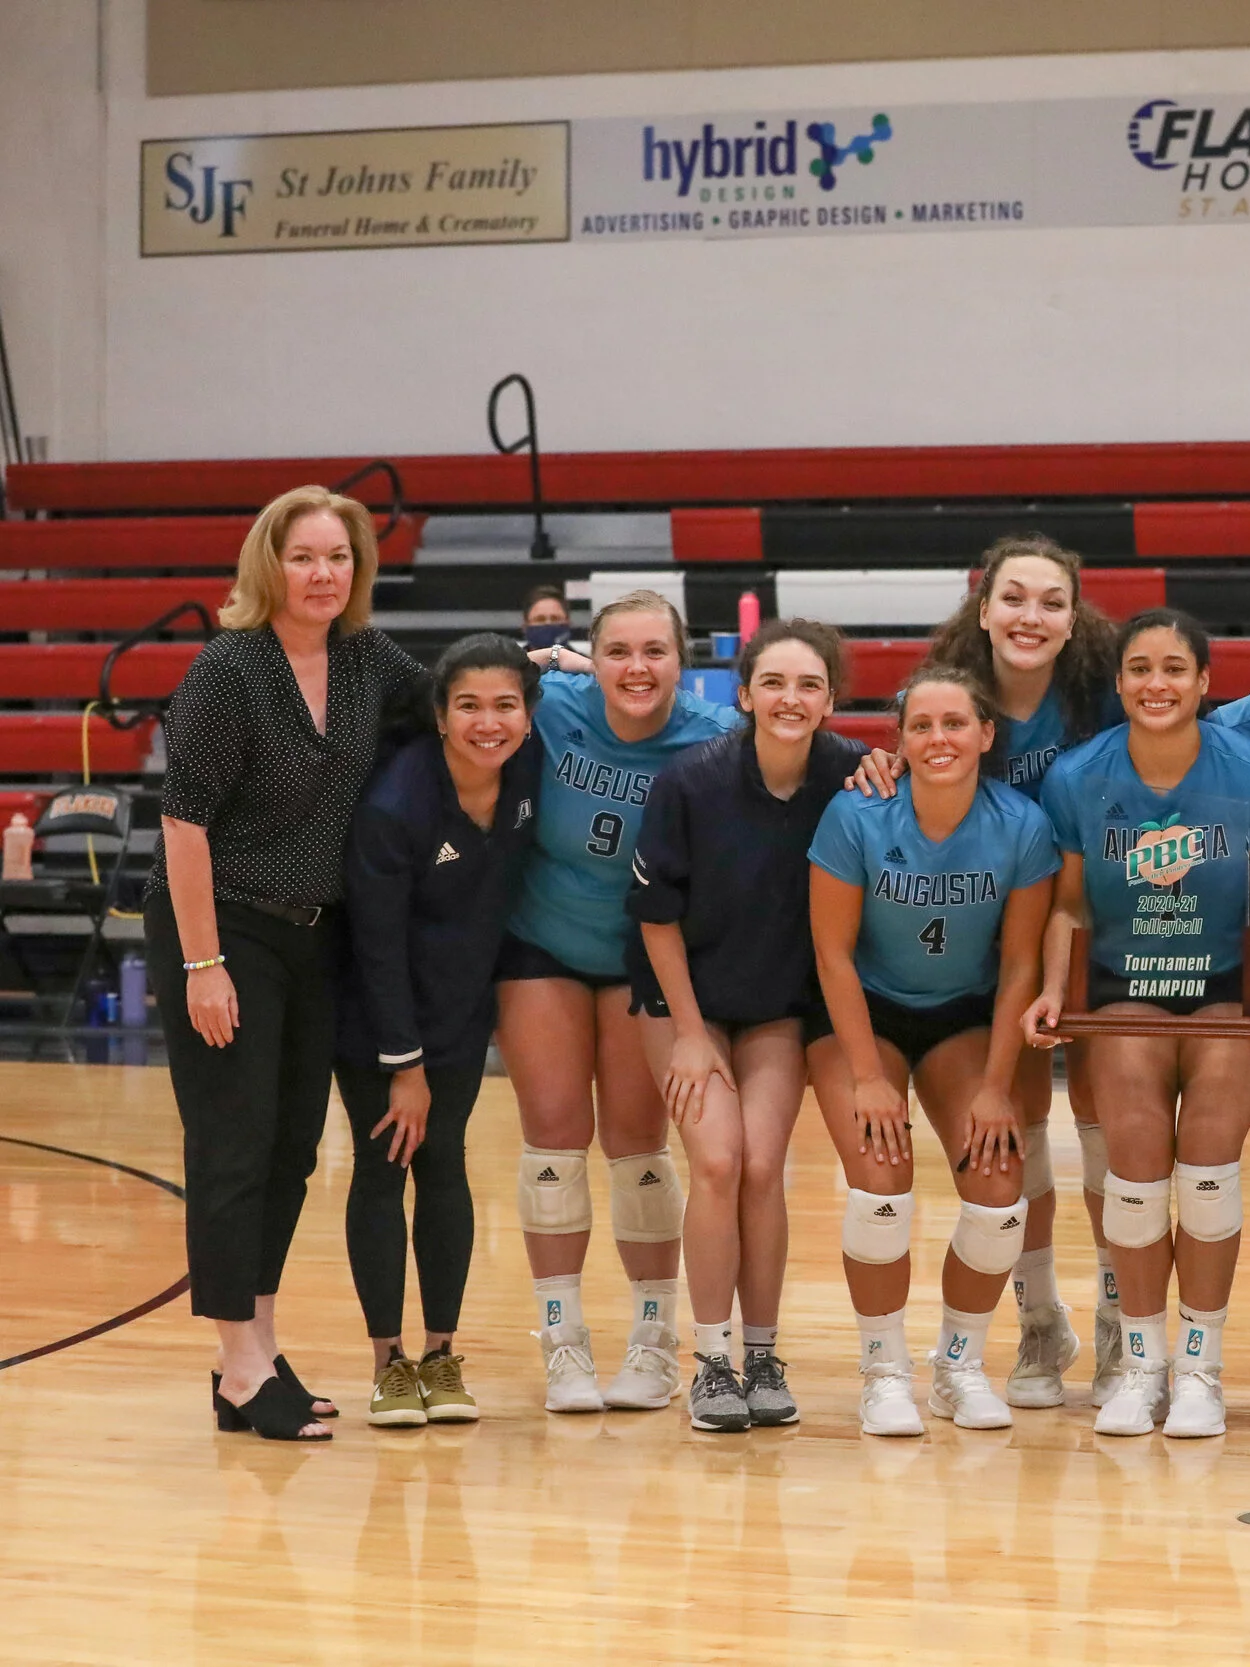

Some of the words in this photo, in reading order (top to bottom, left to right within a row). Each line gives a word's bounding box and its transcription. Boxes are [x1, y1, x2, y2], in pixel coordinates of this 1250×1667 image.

[643, 120, 797, 197] hybrid
[164, 152, 254, 238] SJF
[276, 167, 309, 198] St
[317, 164, 413, 197] Johns
[425, 159, 538, 197] Family
[700, 185, 795, 203] DESIGN
[275, 218, 350, 239] Funeral
[355, 216, 410, 236] Home
[416, 214, 430, 234] &
[439, 214, 539, 234] Crematory
[581, 211, 704, 235] ADVERTISING
[729, 207, 809, 230] GRAPHIC
[817, 205, 886, 226] DESIGN
[911, 201, 1024, 223] MARKETING
[556, 750, 656, 807] AUGUS
[586, 810, 625, 858] 9
[1126, 828, 1205, 881] PBC
[874, 868, 998, 907] AUGUSTA
[1137, 895, 1198, 913] 2020-21
[917, 916, 947, 955] 4
[1132, 917, 1204, 938] Volleyball
[1125, 954, 1212, 972] Tournament
[1128, 979, 1206, 998] CHAMPION
